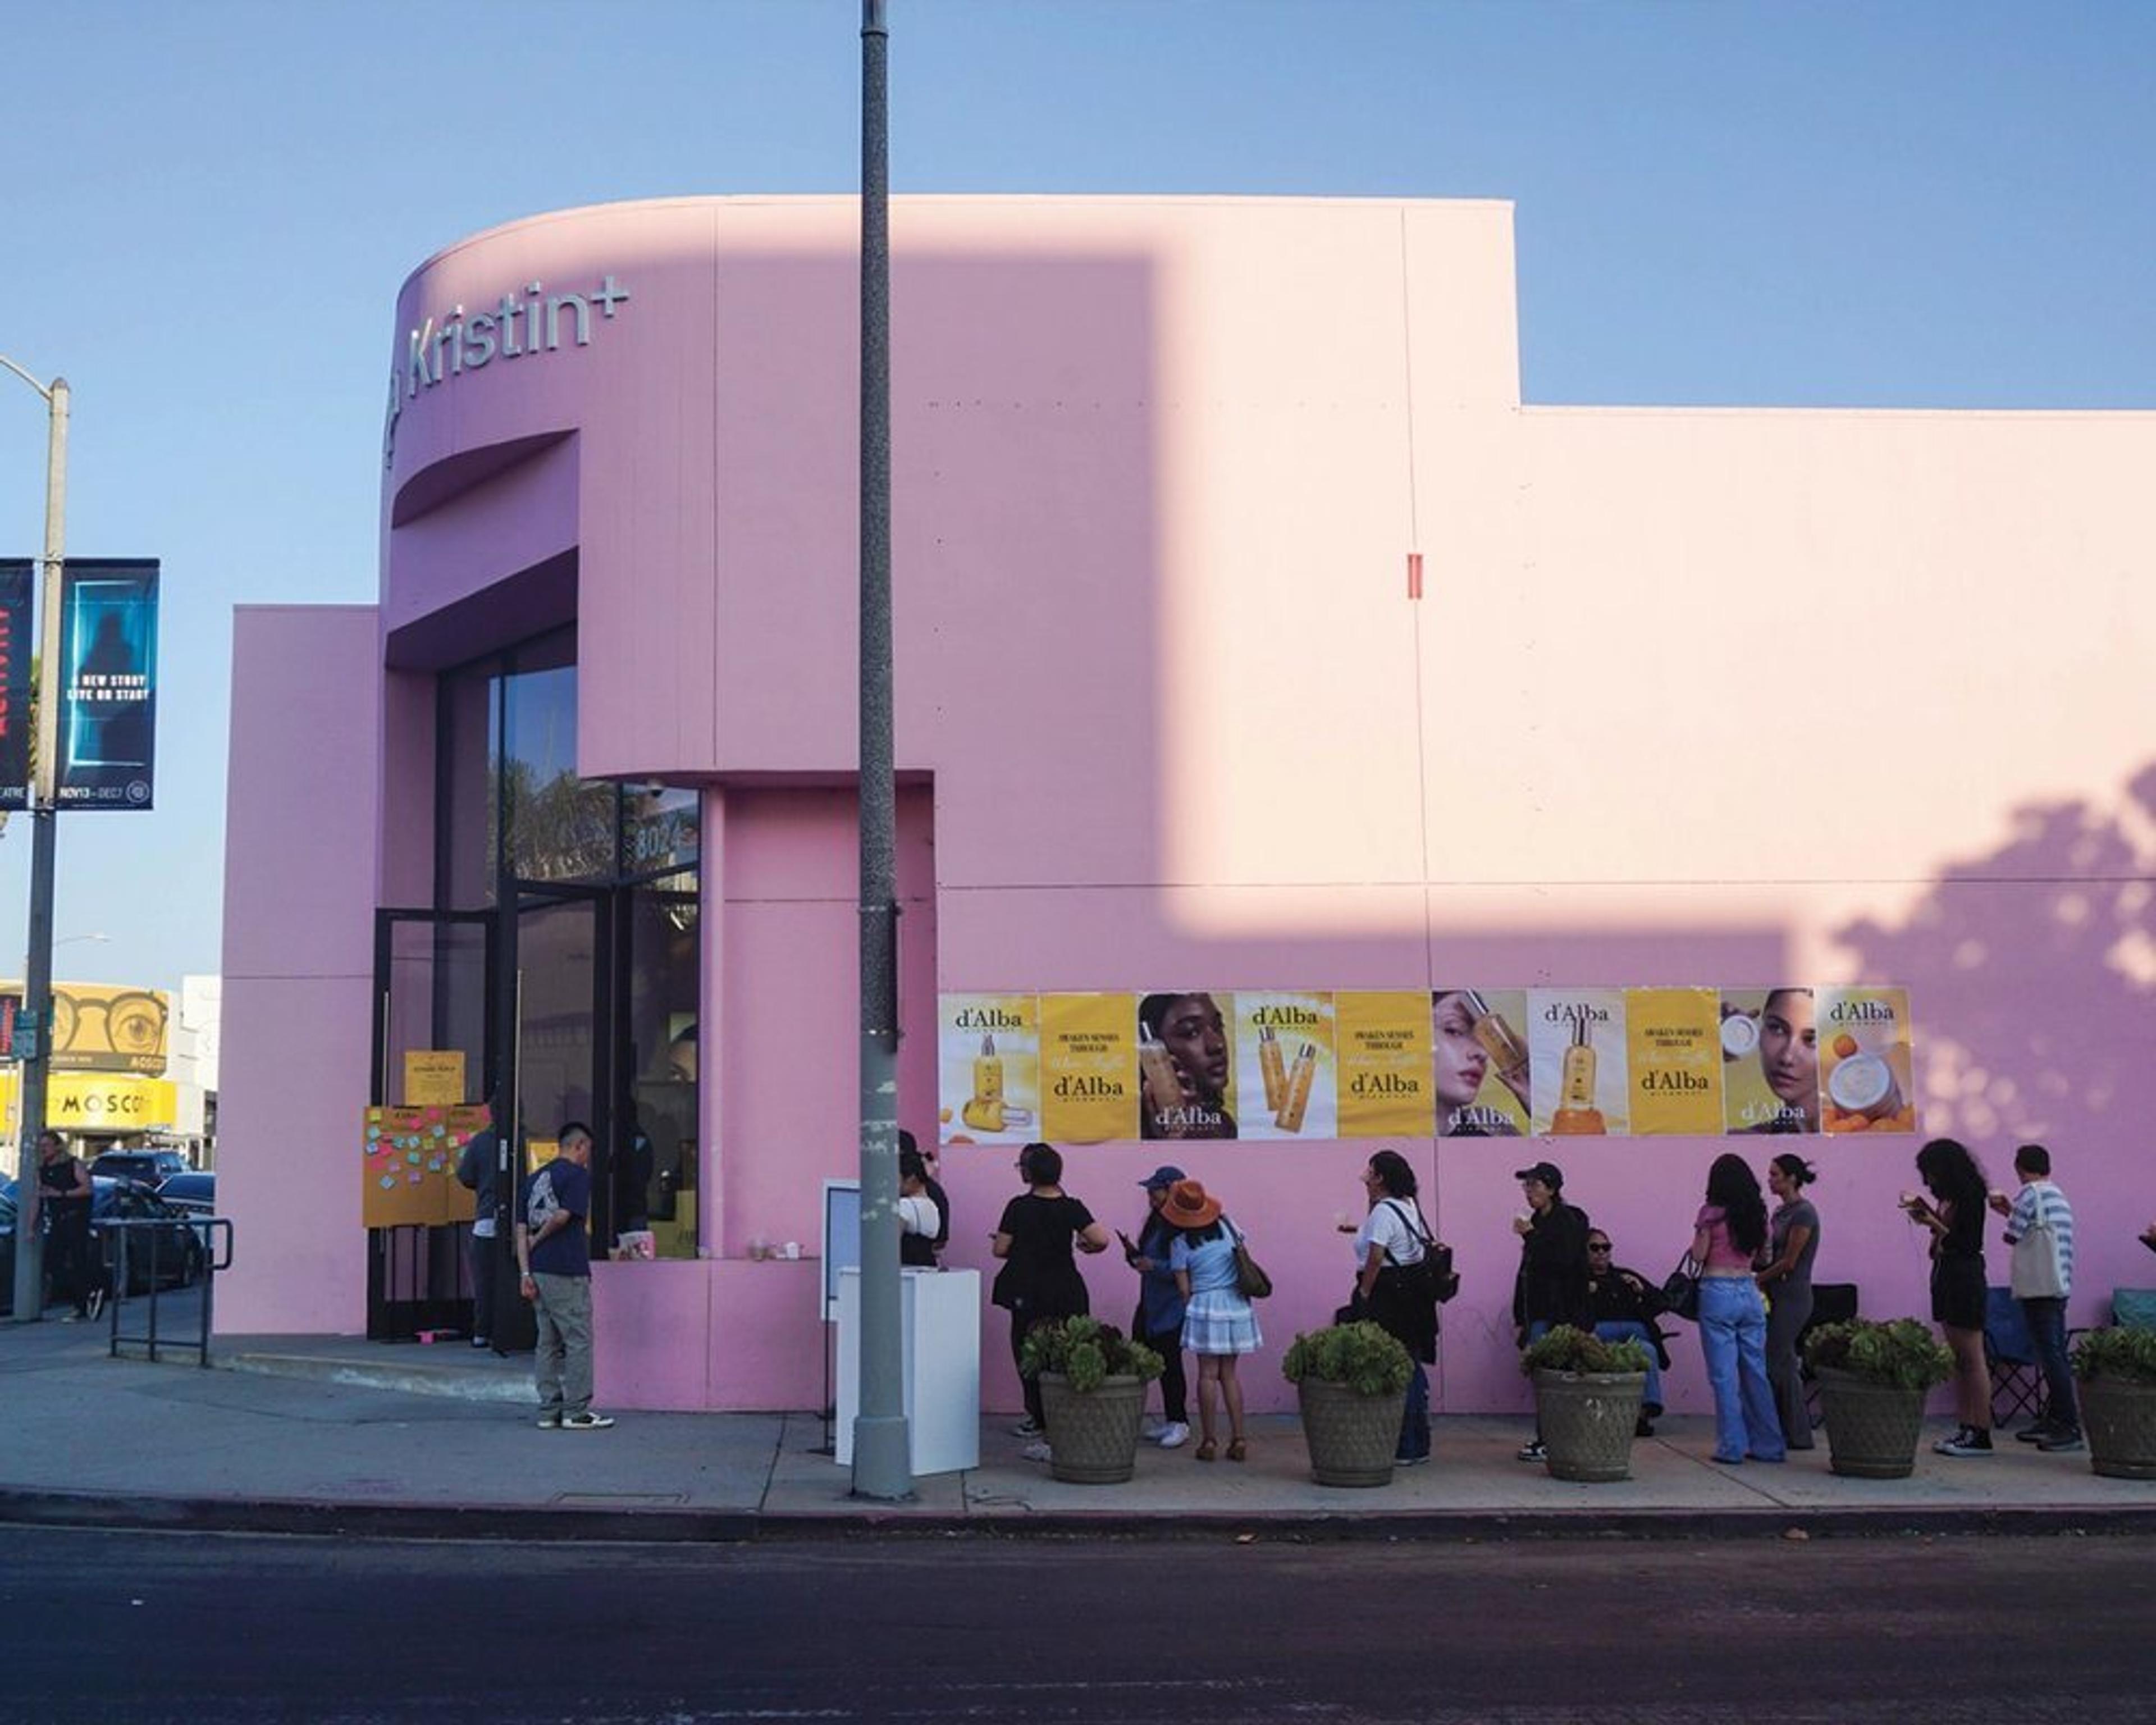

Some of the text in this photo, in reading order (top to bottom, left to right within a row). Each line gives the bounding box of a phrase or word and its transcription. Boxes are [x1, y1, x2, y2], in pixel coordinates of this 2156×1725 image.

[956, 1008, 1022, 1028] d'Alba
[1252, 1005, 1318, 1025] d'Alba
[1545, 1002, 1609, 1022] d'Alba
[1830, 1001, 1894, 1021] d'Alba
[1054, 1075, 1123, 1096] d'Alba
[1351, 1072, 1419, 1093] d'Alba
[1641, 1069, 1709, 1090] d'Alba
[62, 1095, 145, 1113] MOSCO
[1155, 1105, 1222, 1125] d'Alba
[1448, 1105, 1514, 1125] d'Alba
